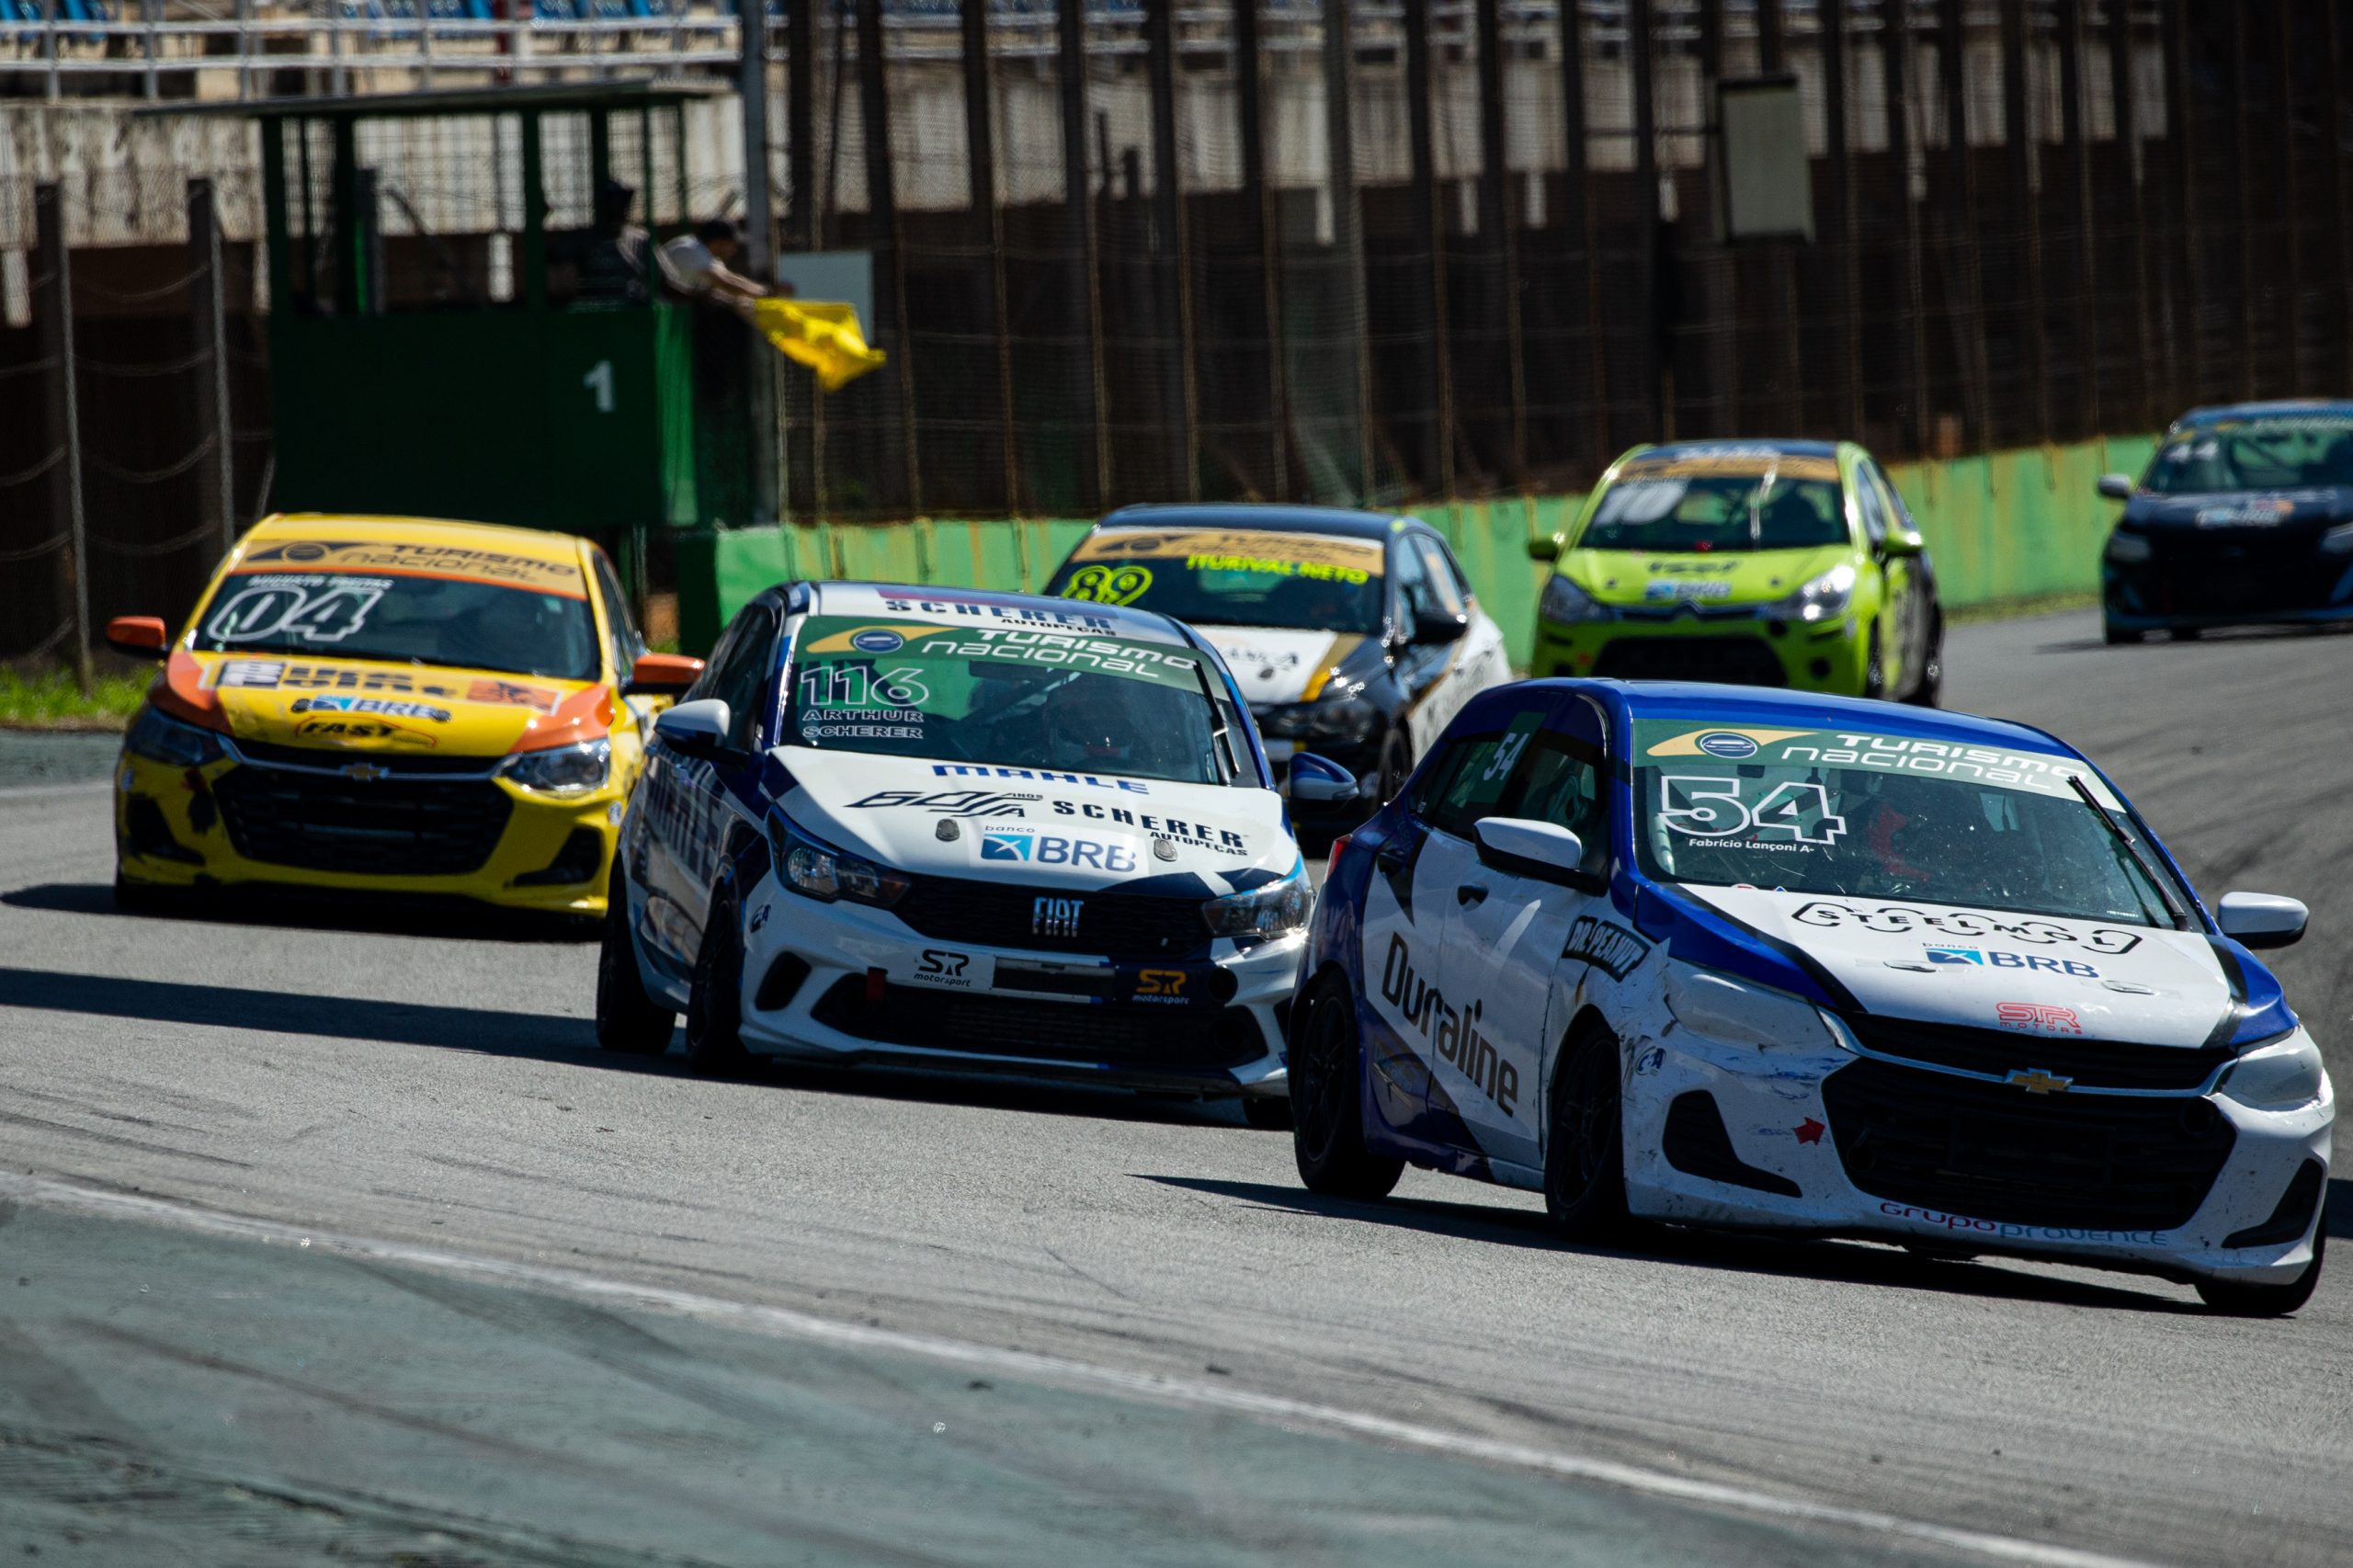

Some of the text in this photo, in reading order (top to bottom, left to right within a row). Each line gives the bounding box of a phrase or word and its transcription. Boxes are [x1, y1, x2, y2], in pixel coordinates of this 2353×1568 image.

[583, 359, 615, 413] 1
[336, 552, 538, 583] nacional
[393, 543, 576, 578] TURISMO
[1062, 565, 1153, 606] 89
[207, 585, 384, 642] 04
[885, 599, 1111, 629] SCHERER
[922, 642, 1159, 678] nacional
[977, 629, 1197, 670] TURISMO
[800, 665, 929, 707] 116
[801, 709, 925, 723] ARTHUR
[801, 725, 924, 739] SCHERER
[1483, 733, 1529, 781] 54
[1780, 746, 2052, 790] nacional
[1836, 734, 2088, 781] TURISMO
[932, 765, 1151, 794] MAHLE
[1052, 800, 1245, 848] SCHERER
[1658, 775, 1847, 846] 54
[984, 824, 1036, 834] banco
[1688, 837, 1742, 848] Fabrício
[1745, 840, 1797, 852] Lançoni
[1037, 835, 1136, 873] BRB
[1032, 897, 1085, 937] FIAT
[1817, 909, 2116, 947] STEELMOL
[919, 949, 970, 977] SR
[1922, 941, 1978, 950] banco
[914, 972, 971, 987] motorsport
[1136, 969, 1187, 994] SR
[1987, 951, 2099, 979] BRB
[1131, 993, 1189, 1005] motorsport
[1995, 1002, 2082, 1029] STR
[1381, 931, 1518, 1118] Duraline
[1999, 1021, 2083, 1035] MOTORS
